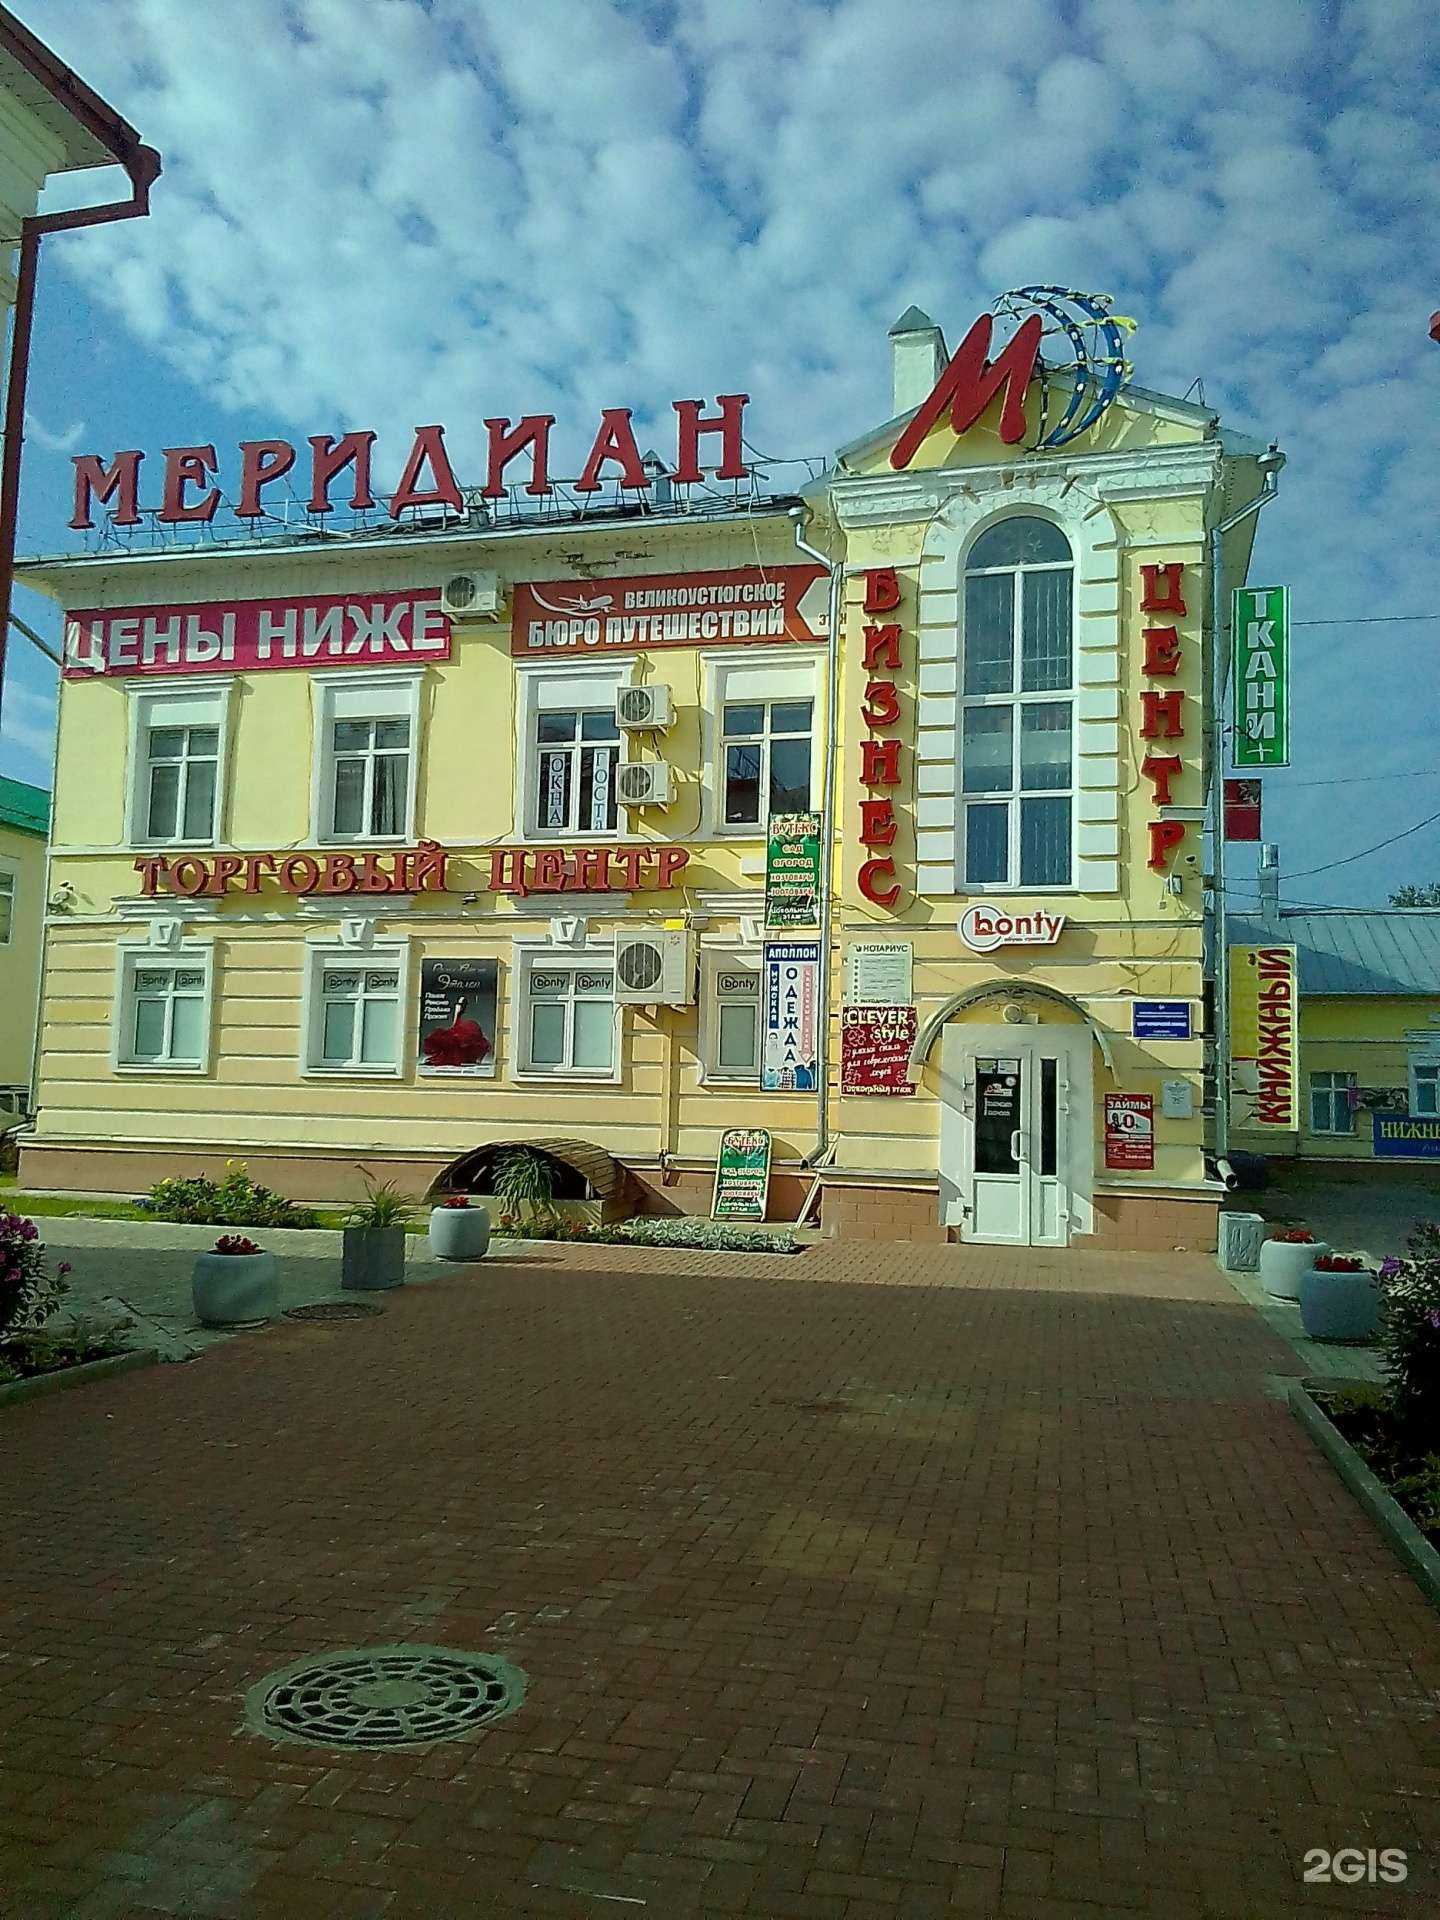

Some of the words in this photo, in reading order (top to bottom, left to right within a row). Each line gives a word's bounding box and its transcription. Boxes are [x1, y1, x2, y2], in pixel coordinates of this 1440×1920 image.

[70, 393, 750, 530] МЕРИДИАН
[624, 583, 785, 609] ВЕЛИКОУСТЮГСКОЕ
[66, 612, 236, 672] ЦЕНЫ
[257, 600, 445, 659] НИЖЕ
[528, 617, 599, 648] БЮРО
[605, 602, 785, 645] ПУТЕШЕСТВИЙ
[858, 567, 902, 906] БИЗНЕС
[1139, 563, 1187, 869] ЦЕНТР
[549, 758, 564, 824] ОКНА
[134, 840, 448, 896] ТОРГОВЫЙ
[489, 847, 691, 896] ЦЕНТР
[773, 859, 814, 867] ОГОРОД
[782, 844, 803, 853] САД
[974, 910, 1063, 941] bonty
[769, 948, 817, 959] АПОЛЛОН
[863, 945, 909, 953] НОТАРИУС
[783, 967, 799, 1062] ОДЕЖДА
[847, 1010, 909, 1025] CLEVER
[873, 1025, 910, 1042] style
[1248, 948, 1292, 1124] КНИЖНЫЙ
